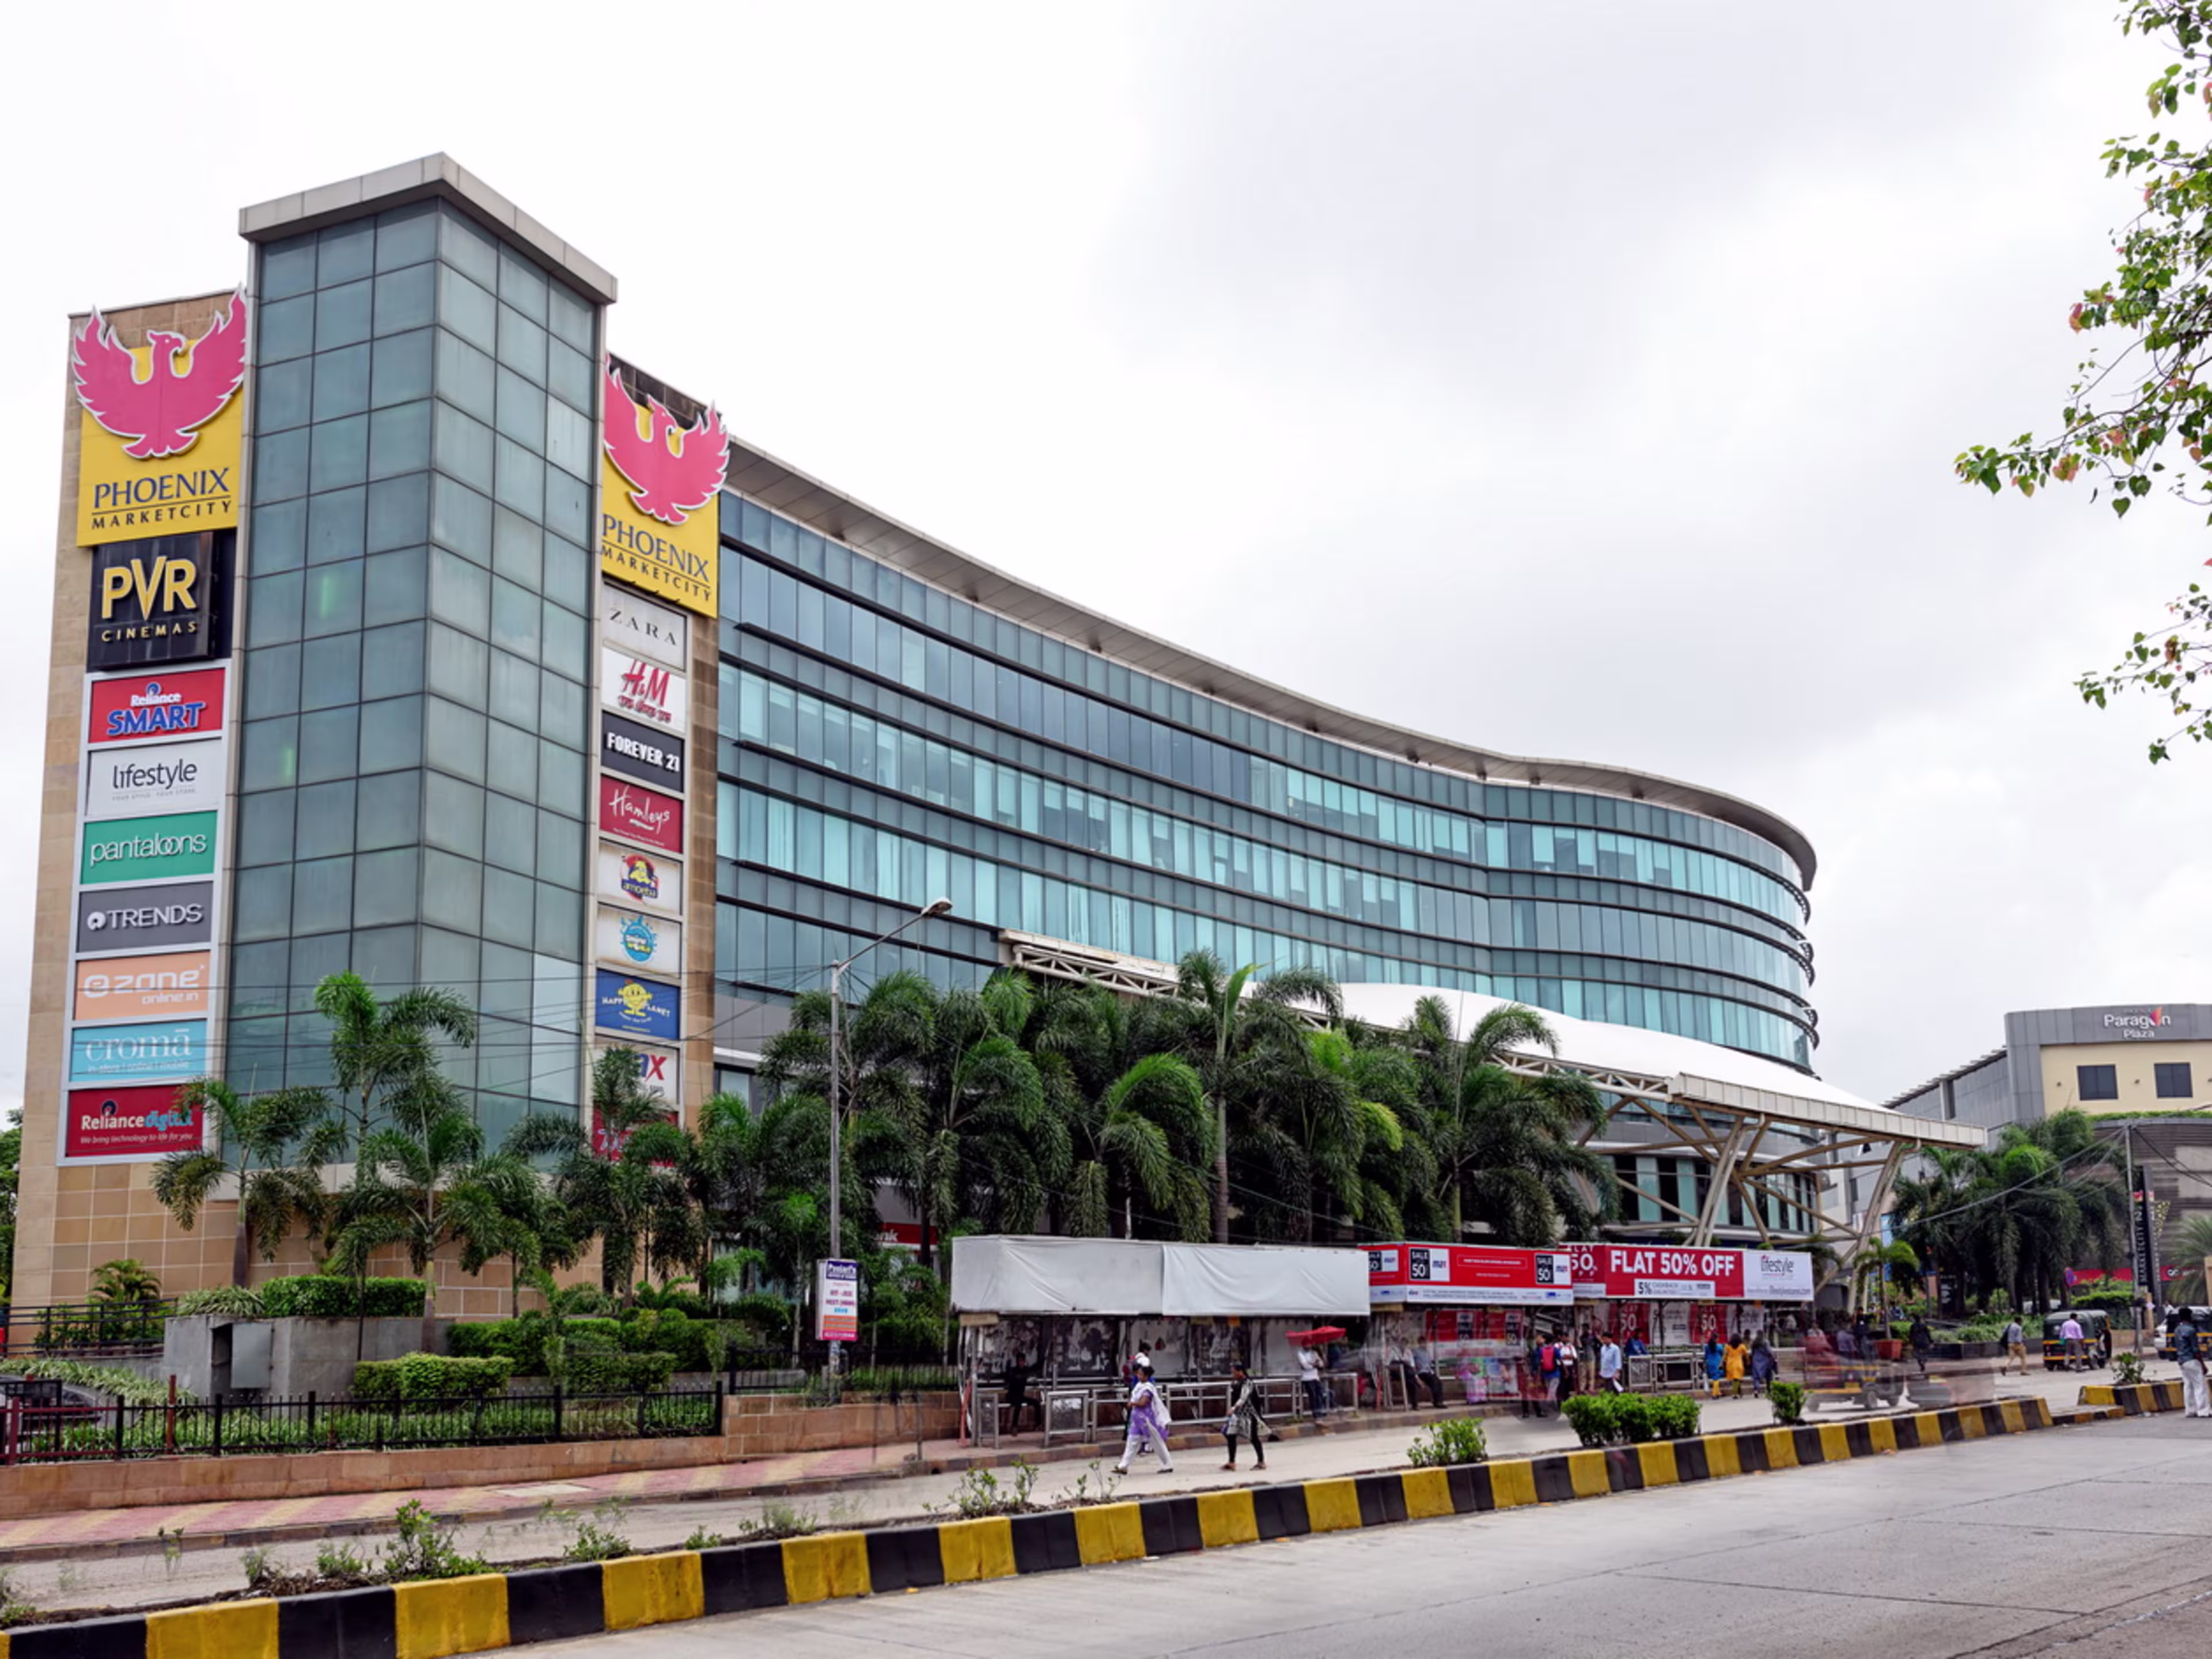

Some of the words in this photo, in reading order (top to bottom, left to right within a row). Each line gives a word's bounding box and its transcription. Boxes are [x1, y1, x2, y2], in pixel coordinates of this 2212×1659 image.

[94, 467, 229, 509] PHOENIX
[92, 500, 231, 529] MARKETCITY
[602, 514, 709, 582] PHOENIX
[101, 556, 197, 620] PVR
[601, 545, 711, 601] MARKETCITY
[101, 621, 196, 642] CINEMAS
[609, 607, 677, 646] ZARA
[130, 692, 181, 707] Reliance
[622, 659, 671, 707] H&M
[107, 702, 206, 736] SMART
[607, 732, 662, 767] FOREVER
[665, 753, 680, 772] 21
[112, 759, 198, 790] lifestyle
[608, 784, 671, 835] Hamleys
[90, 832, 207, 866] pantaloons
[105, 903, 203, 929] TRENDS
[2123, 1028, 2155, 1039] Plaza
[634, 1054, 667, 1082] ax
[81, 1110, 144, 1131] Reliance
[1611, 1249, 1656, 1274] FLAT
[1660, 1252, 1698, 1275] 50%
[1701, 1254, 1735, 1277] OFF
